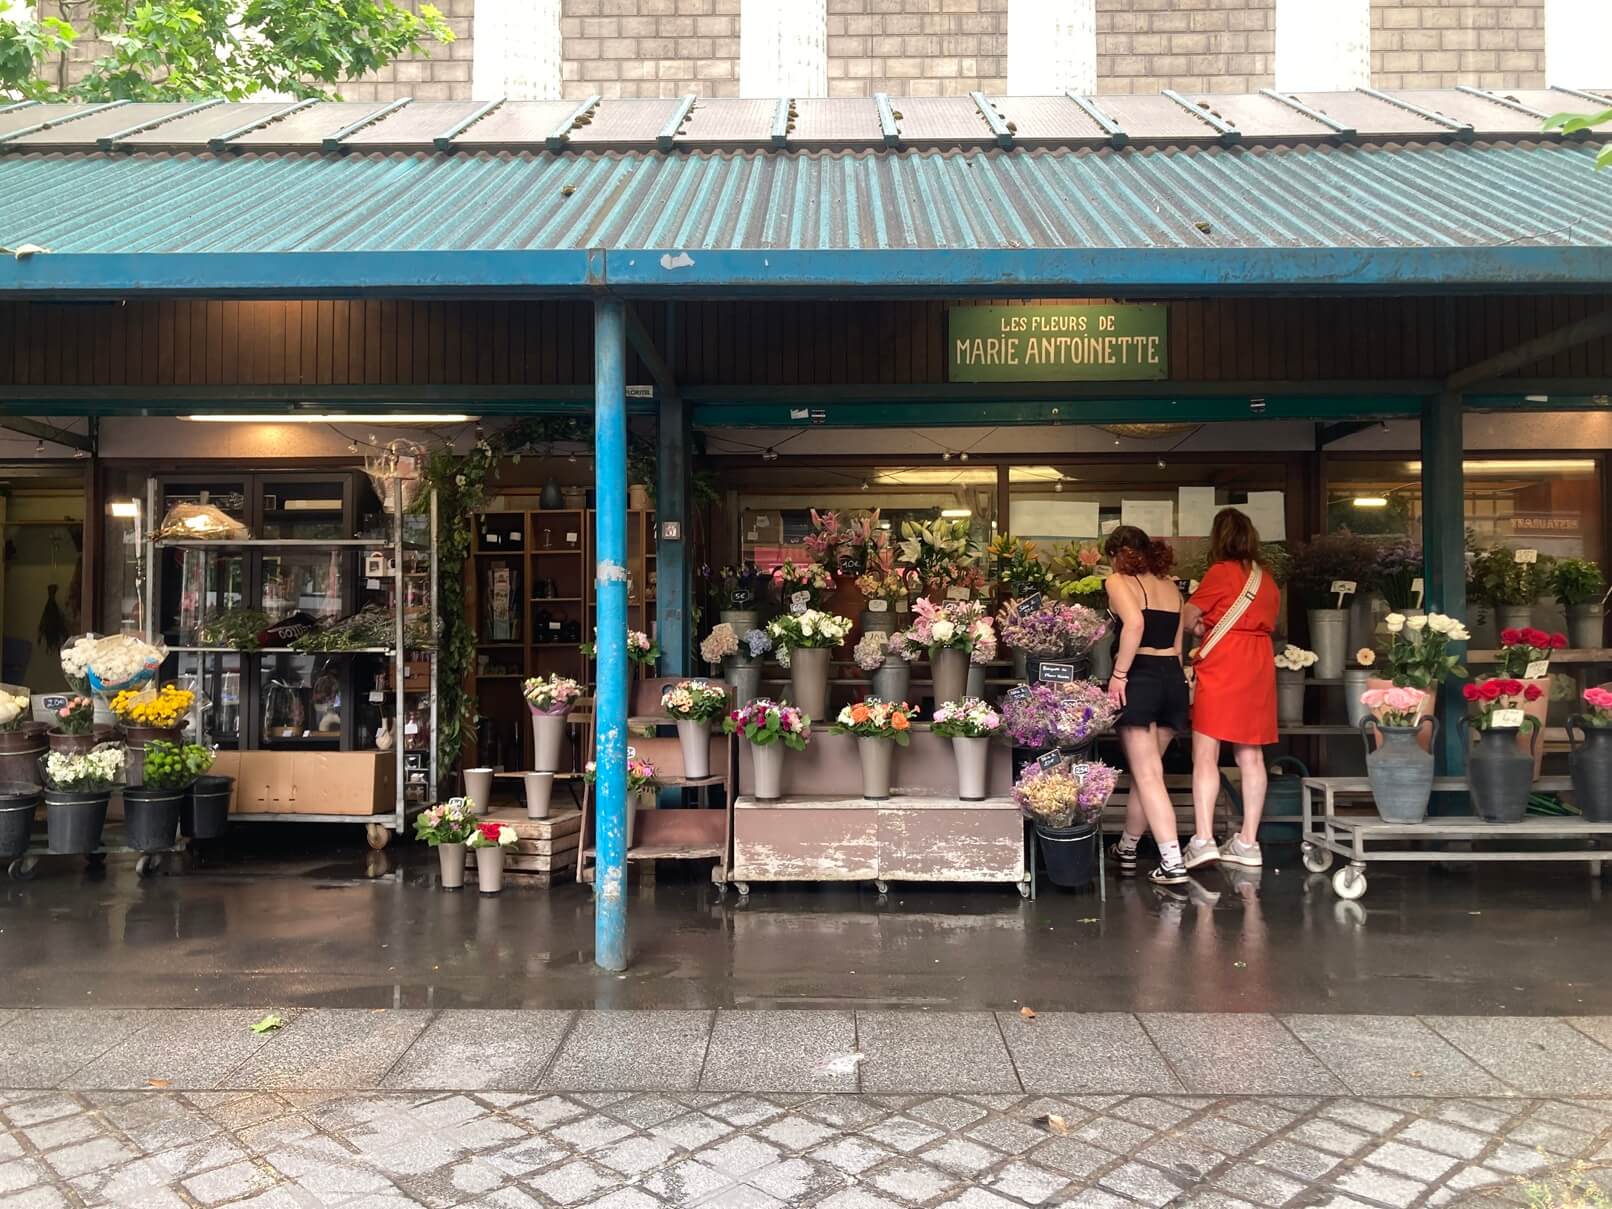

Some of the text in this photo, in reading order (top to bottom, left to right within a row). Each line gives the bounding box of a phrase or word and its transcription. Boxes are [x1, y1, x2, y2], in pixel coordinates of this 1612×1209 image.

[1001, 315, 1115, 332] LES FLEURS DE
[956, 334, 1160, 365] MARIE ANTOINETTE
